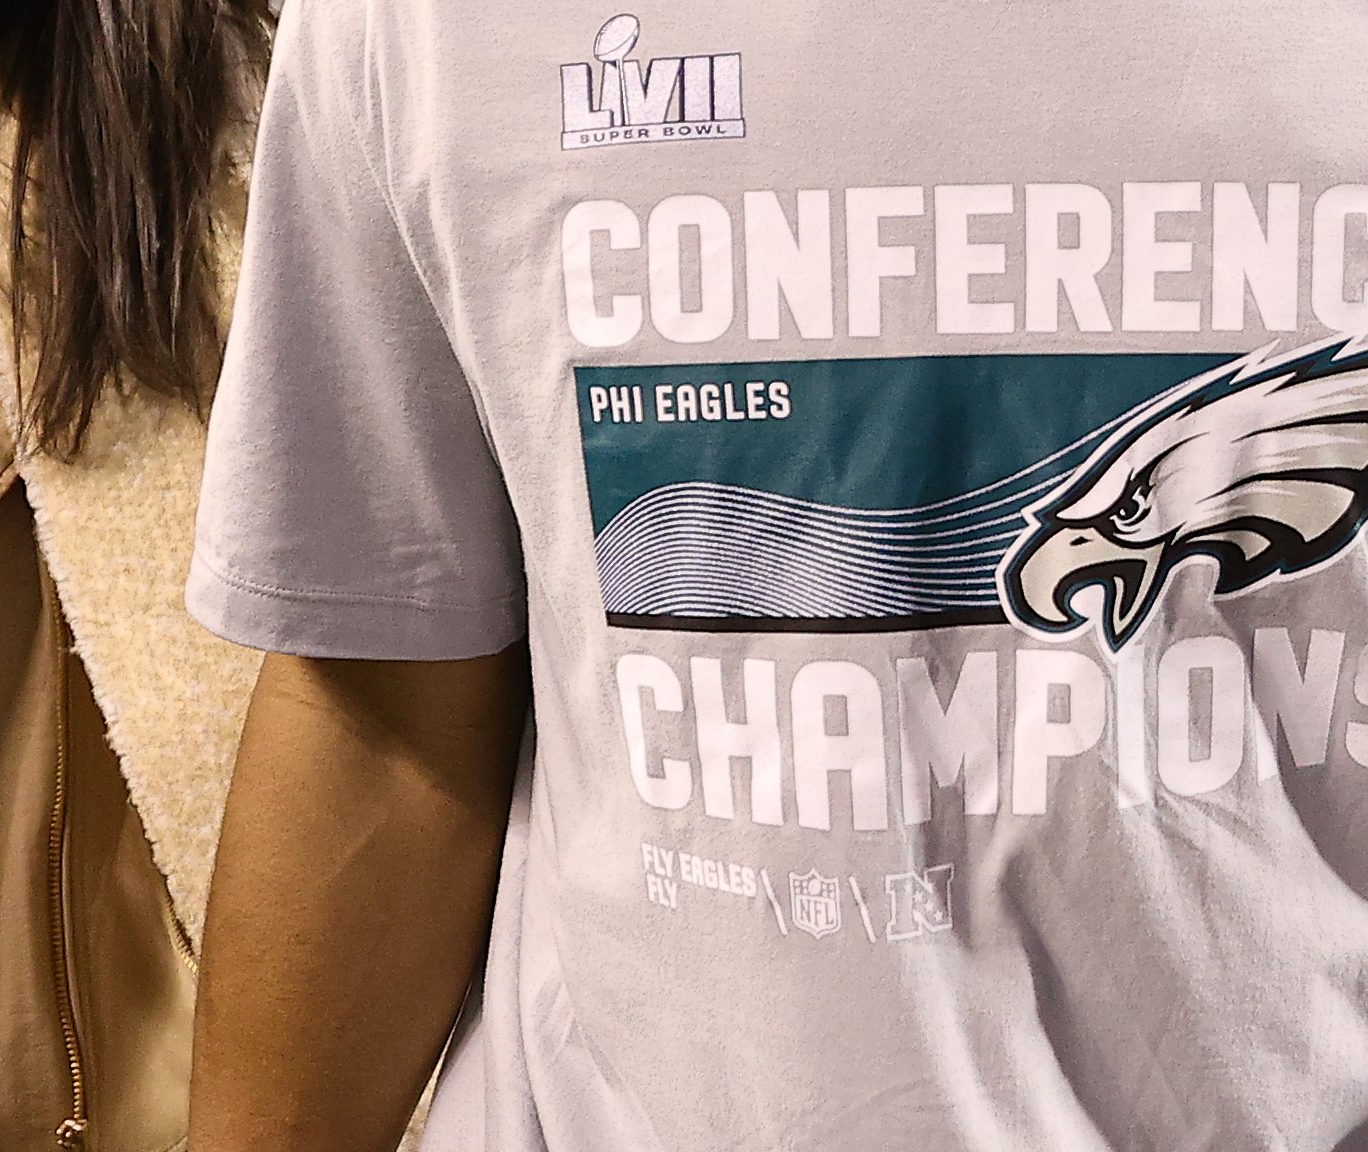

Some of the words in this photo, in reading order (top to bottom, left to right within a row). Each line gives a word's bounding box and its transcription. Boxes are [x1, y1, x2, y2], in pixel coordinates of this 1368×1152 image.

[560, 52, 743, 132] LVII
[579, 127, 650, 145] SUPER
[663, 123, 727, 137] BOWL
[589, 385, 644, 423] PHI
[655, 381, 791, 422] EAGLES
[642, 843, 678, 875] FLY
[679, 851, 759, 898] EAGLES
[646, 873, 679, 909] FLY
